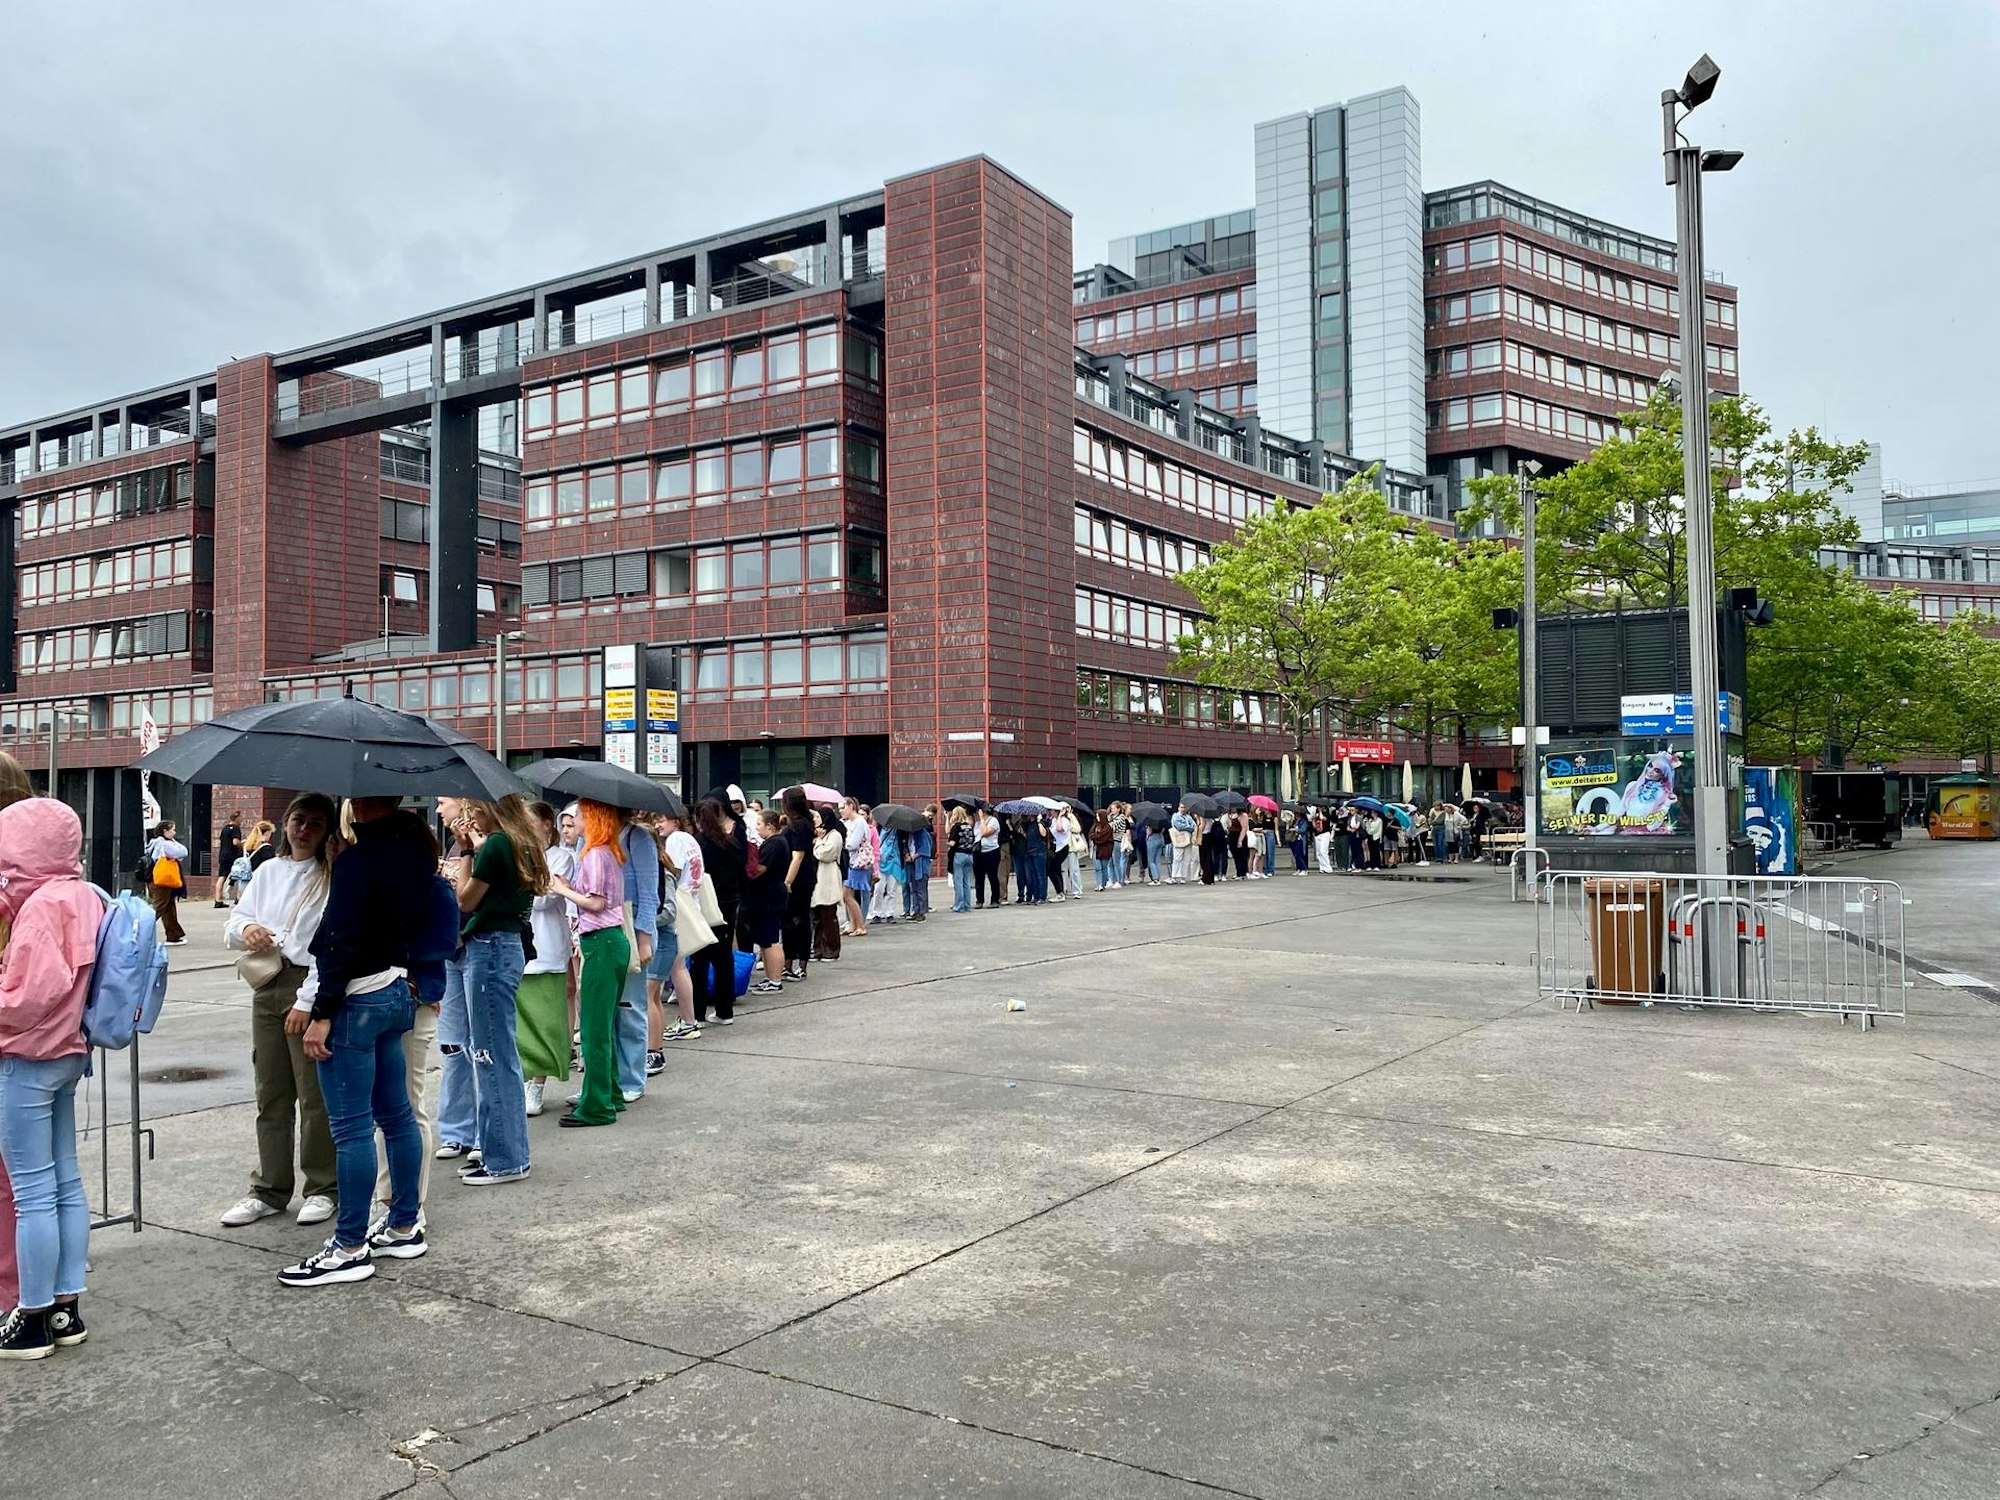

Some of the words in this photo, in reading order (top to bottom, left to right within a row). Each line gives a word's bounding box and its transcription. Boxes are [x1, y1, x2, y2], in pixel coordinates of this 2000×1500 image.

[1547, 758, 1614, 776] DEITERS
[1551, 775, 1614, 786] www.deiters.de
[1549, 817, 1567, 831] SEI
[1569, 813, 1596, 826] WER
[1599, 813, 1617, 825] DU
